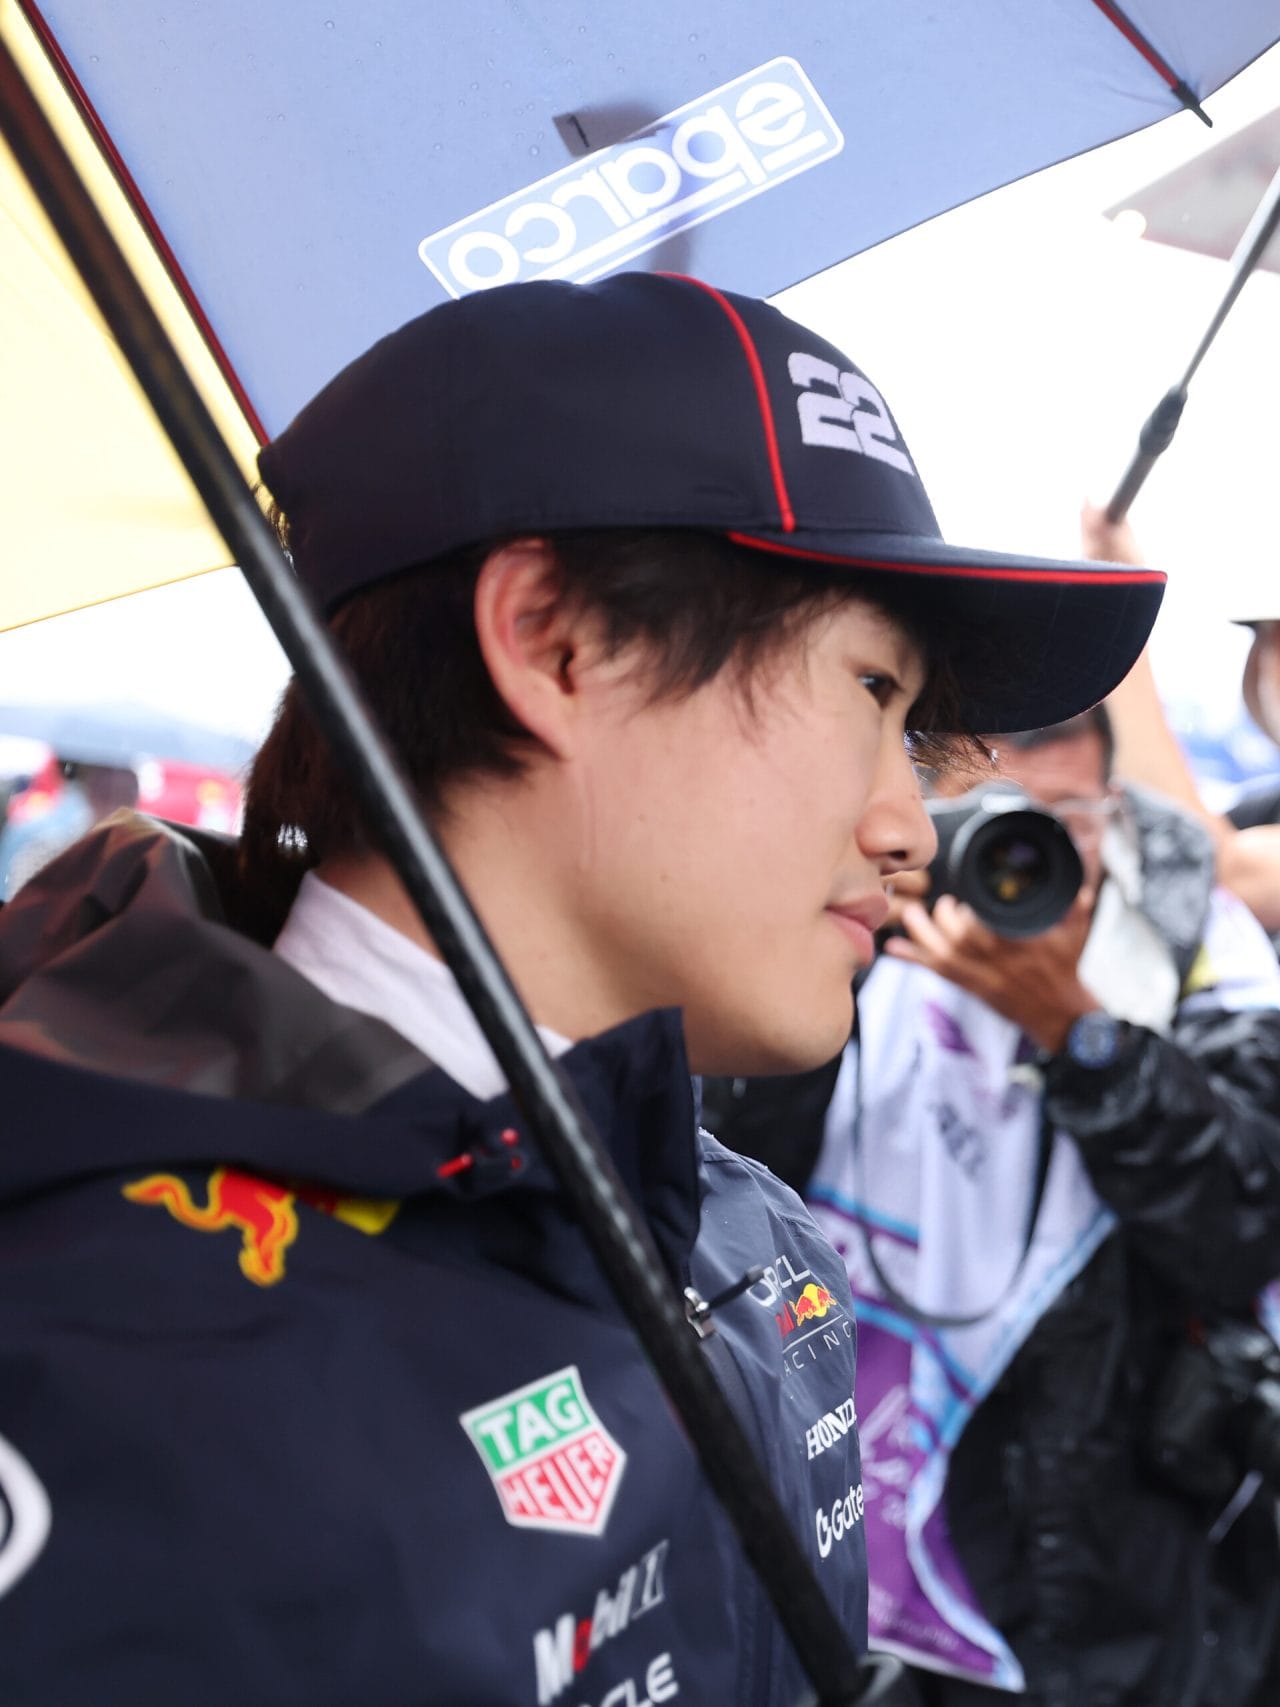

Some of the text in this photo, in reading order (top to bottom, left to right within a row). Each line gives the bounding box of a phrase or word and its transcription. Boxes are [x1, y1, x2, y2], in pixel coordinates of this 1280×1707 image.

[786, 351, 915, 476] 22
[476, 1381, 586, 1462] TAG
[804, 1397, 858, 1461] HOND
[501, 1434, 617, 1521] HEUER
